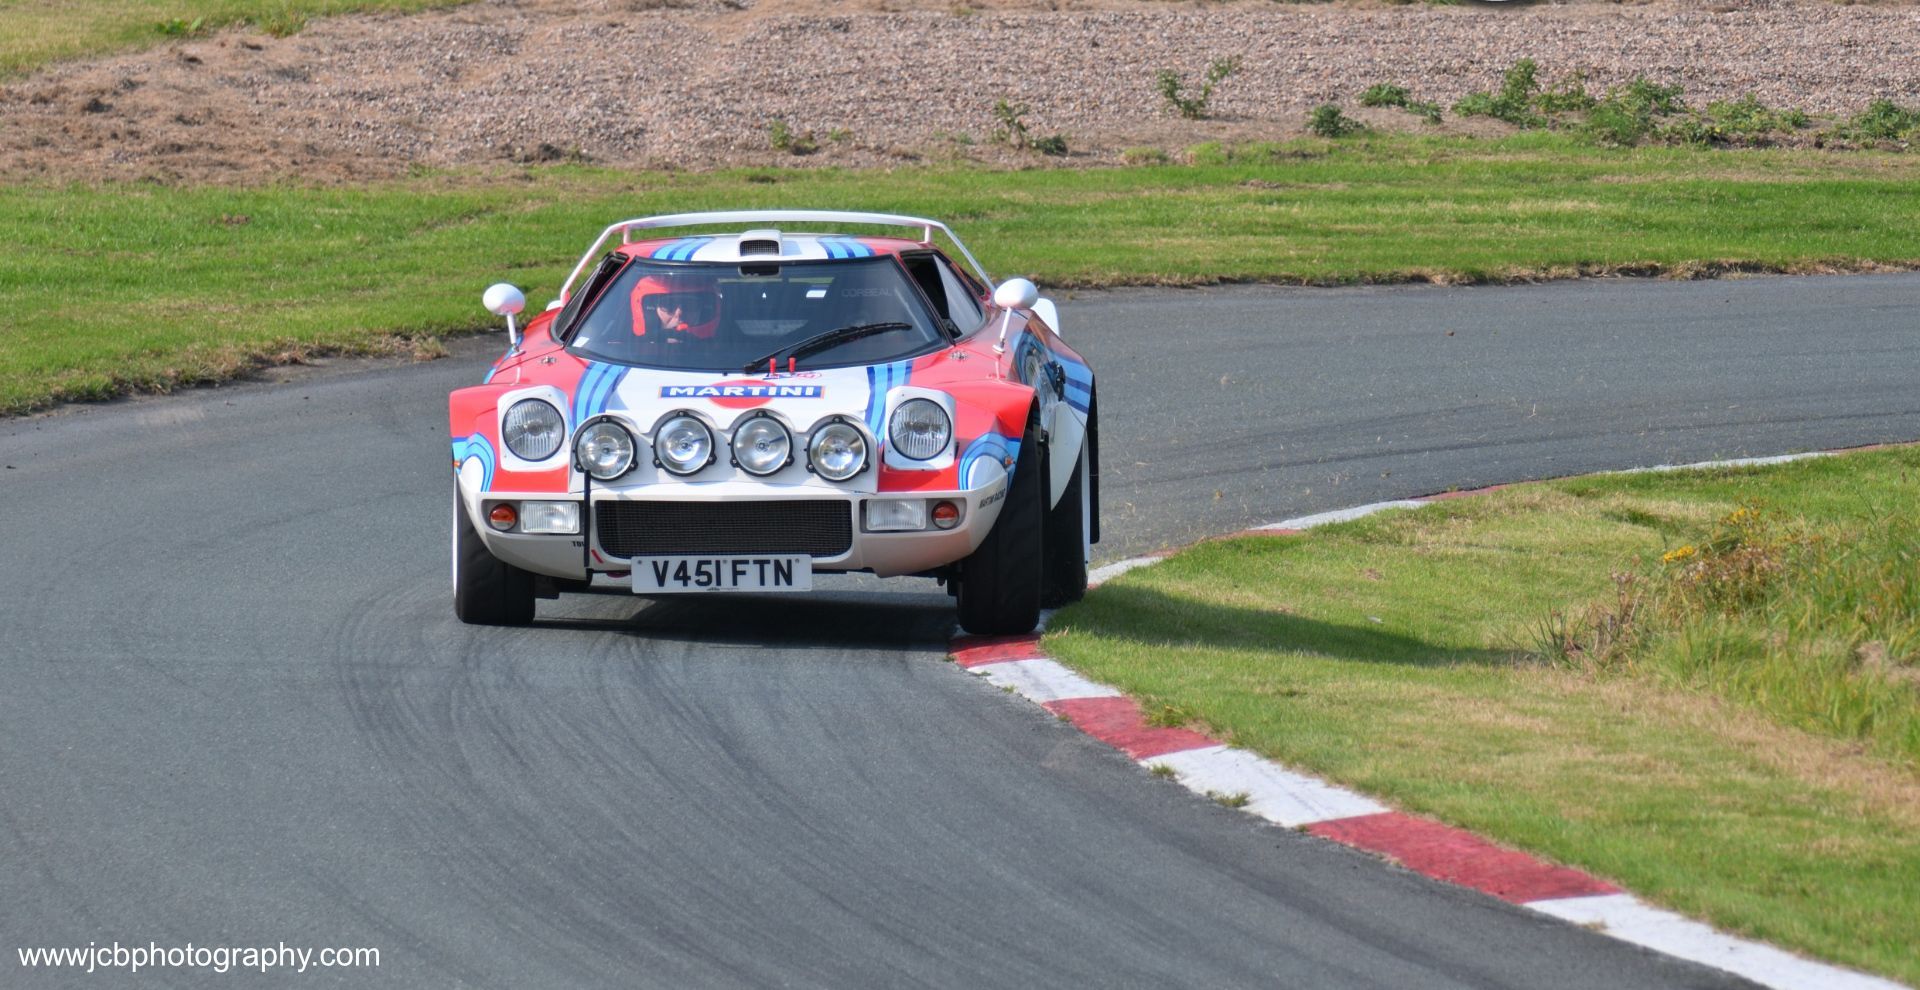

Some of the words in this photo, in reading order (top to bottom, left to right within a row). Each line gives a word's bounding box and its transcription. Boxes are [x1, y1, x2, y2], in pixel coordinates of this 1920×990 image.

[669, 386, 815, 397] MARTINI
[651, 559, 722, 588] V451
[731, 558, 793, 587] FTN
